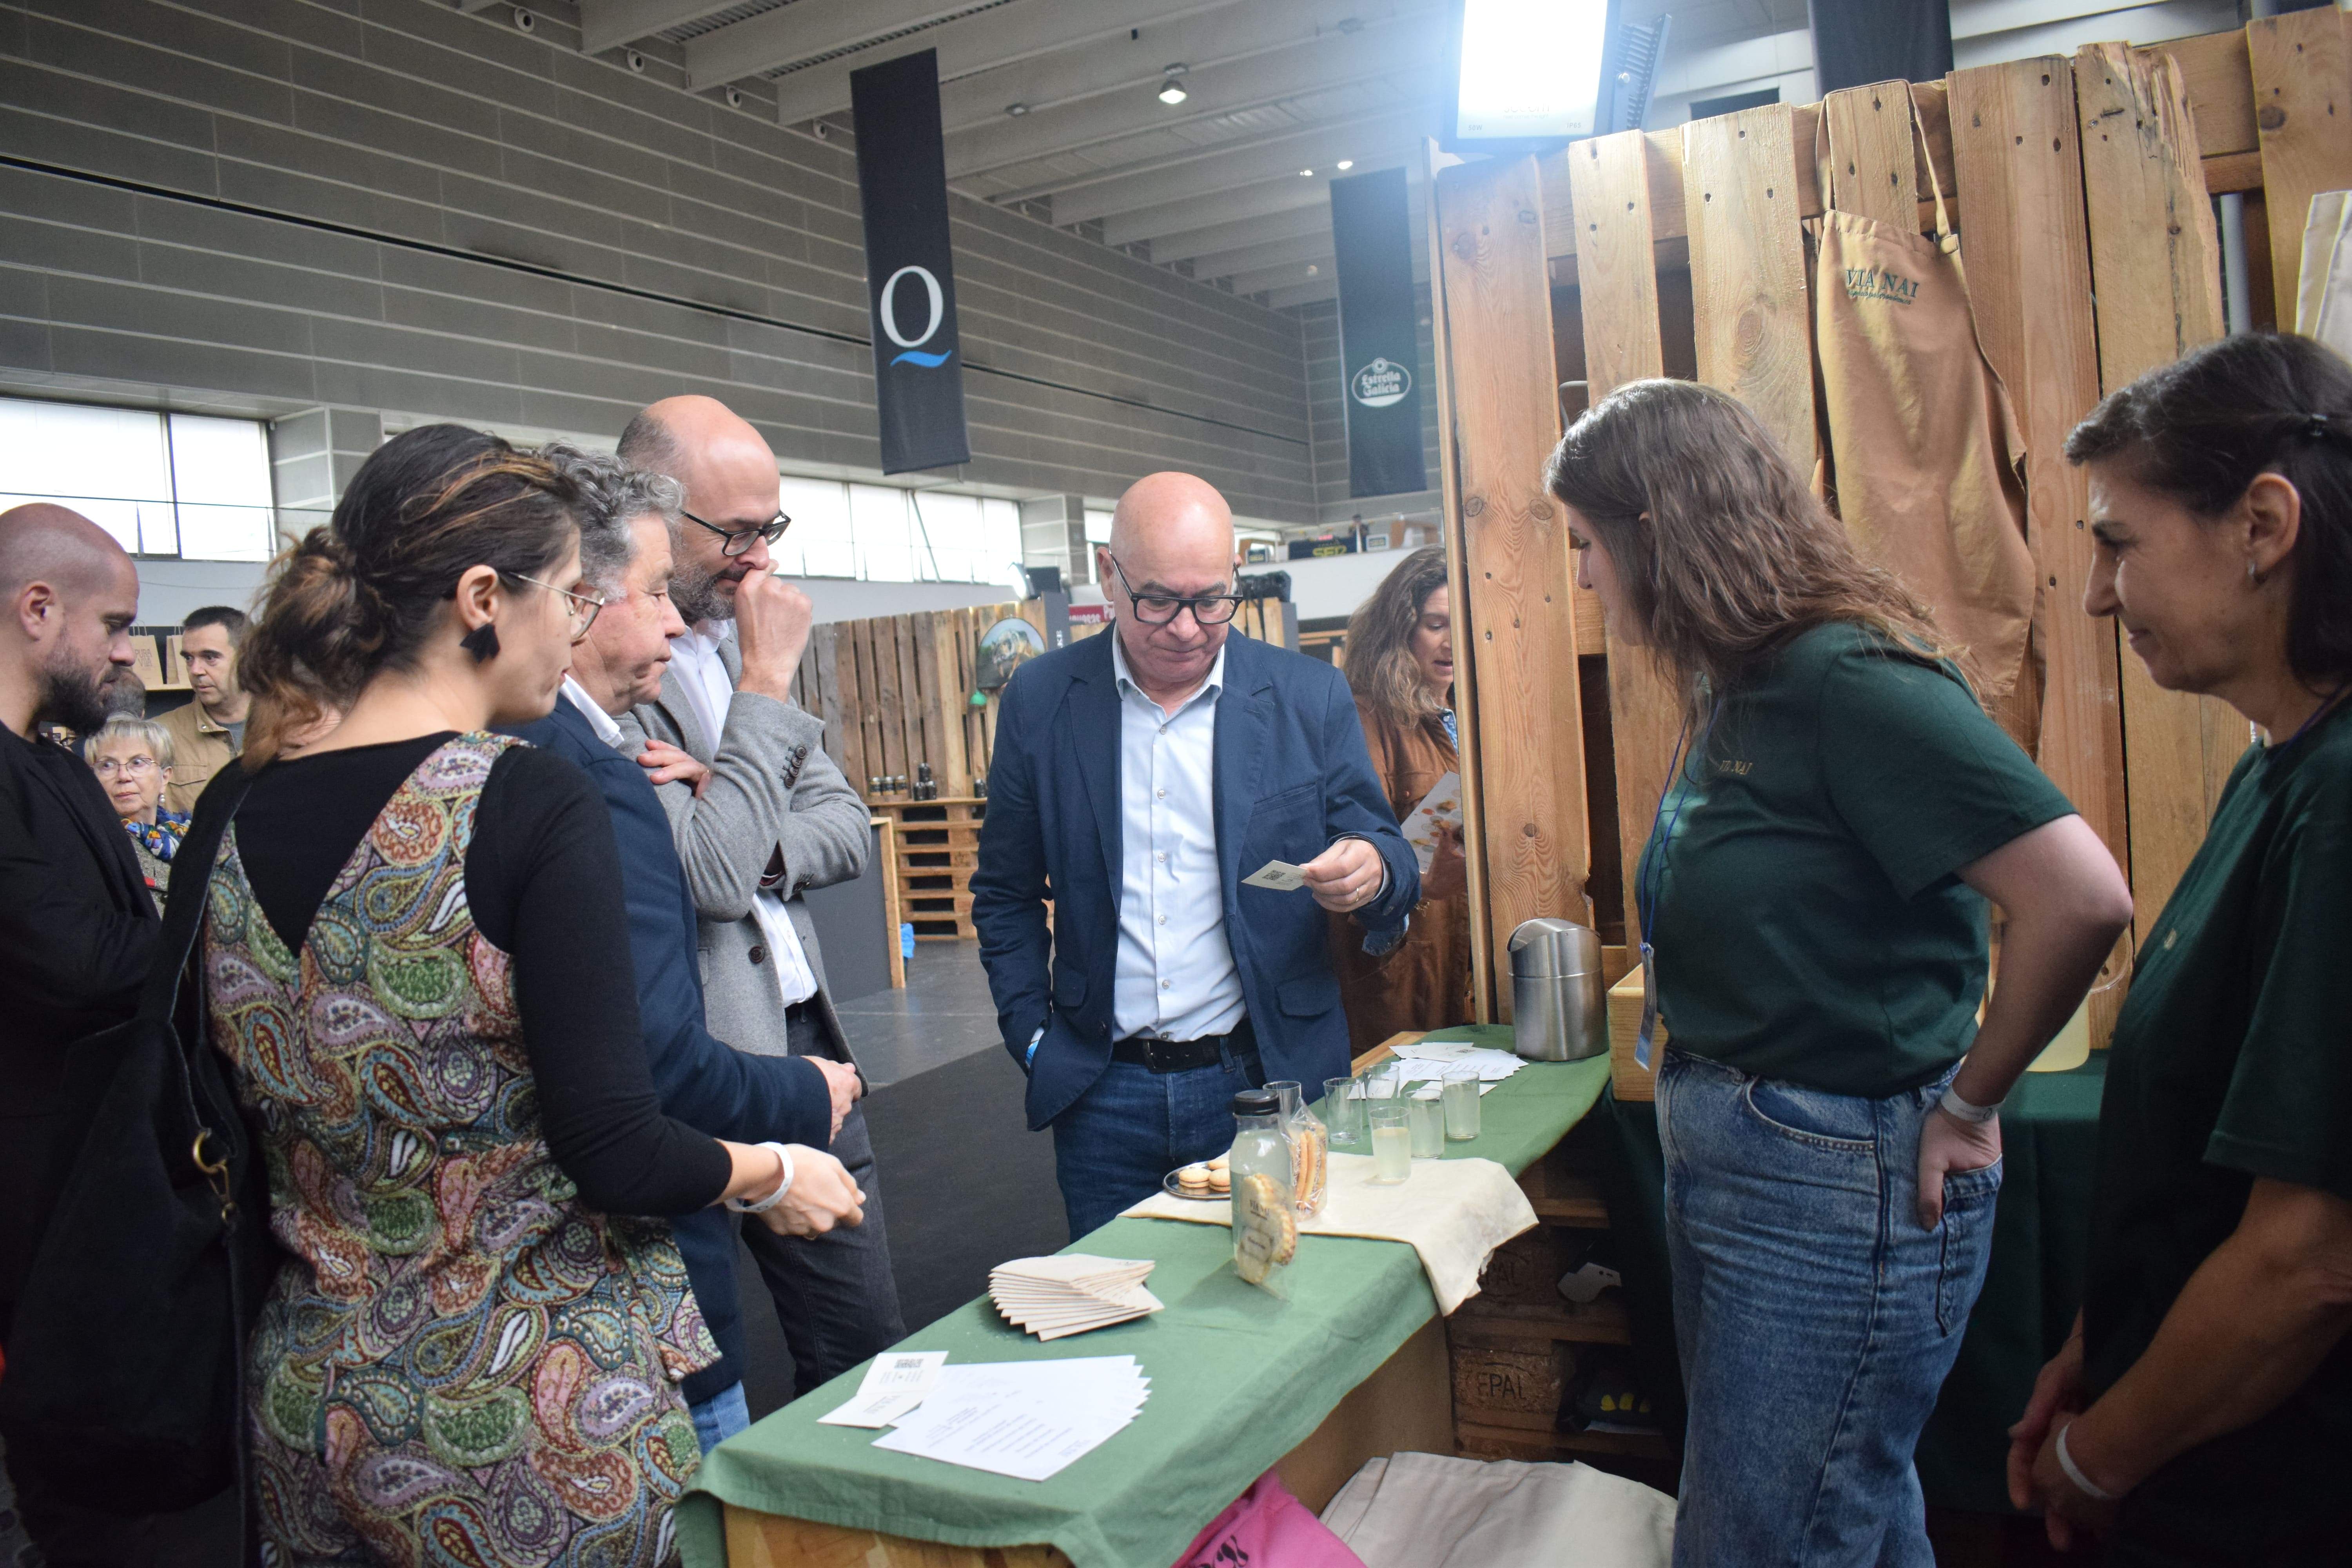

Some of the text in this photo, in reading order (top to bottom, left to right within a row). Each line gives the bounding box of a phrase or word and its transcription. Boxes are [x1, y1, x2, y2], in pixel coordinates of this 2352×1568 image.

[1846, 269, 1920, 298] VIA NAI
[880, 265, 952, 368] Q
[1361, 371, 1401, 385] Estrella
[1363, 383, 1400, 397] Galicia
[134, 649, 152, 658] PURA
